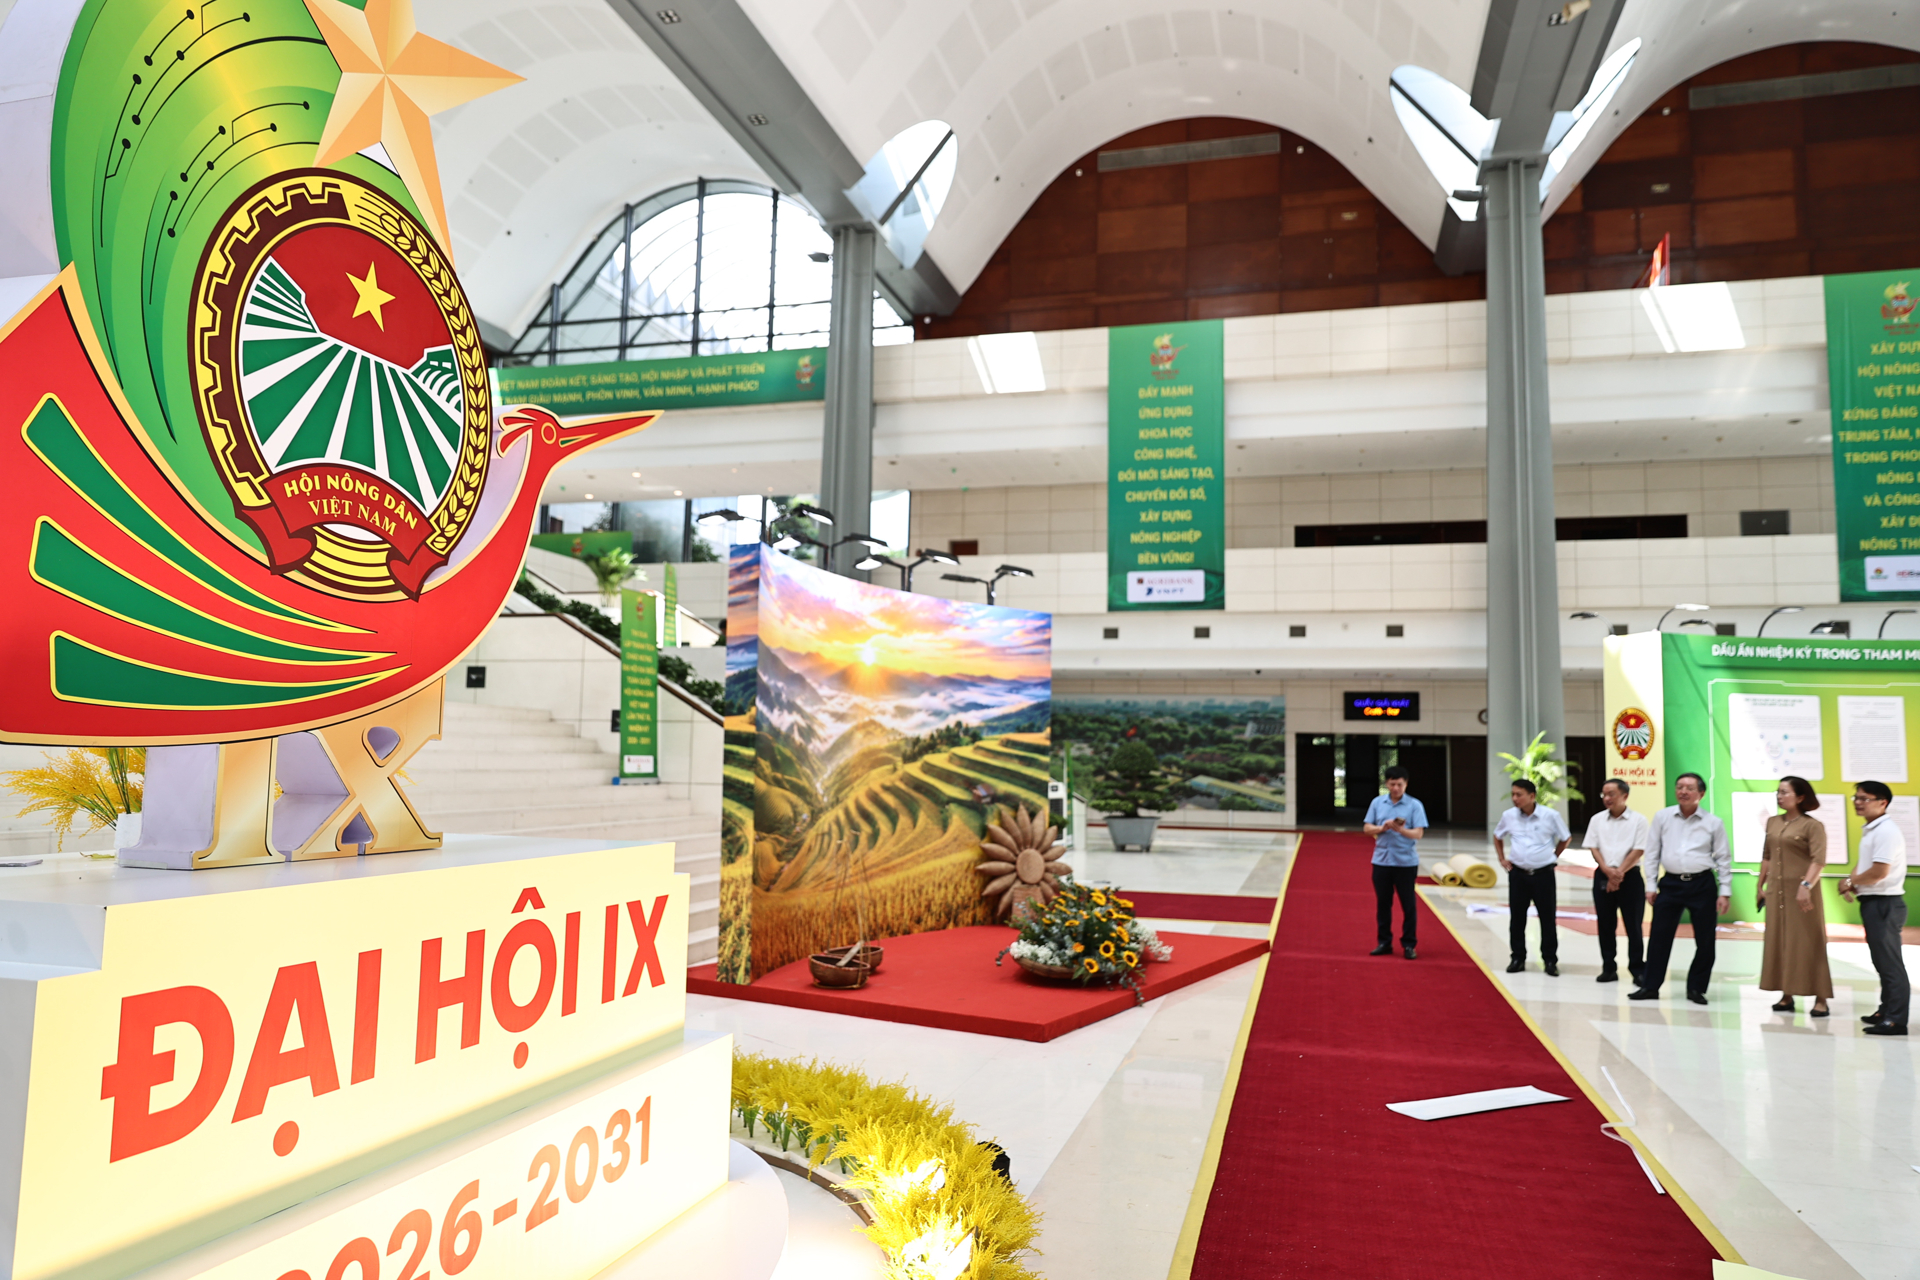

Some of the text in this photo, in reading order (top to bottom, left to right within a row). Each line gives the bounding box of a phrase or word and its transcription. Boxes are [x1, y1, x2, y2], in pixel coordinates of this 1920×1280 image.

[1871, 341, 1896, 355] XÂY
[516, 378, 540, 390] NAM
[590, 372, 616, 386] SÁNG
[641, 368, 659, 382] HỘI
[691, 364, 704, 378] VÀ
[706, 362, 732, 377] PHÁT
[1858, 363, 1880, 379] HỘI
[666, 384, 695, 398] MINH,
[696, 382, 726, 397] HẠNH
[1161, 385, 1193, 399] MẠNH
[1874, 383, 1903, 398] VIỆT
[1842, 404, 1918, 421] XỨNG ĐÁNG
[1139, 426, 1193, 440] KHOA HỌC
[1838, 430, 1880, 443] TRUNG
[1882, 426, 1914, 442] TÂM,
[1134, 446, 1164, 461] CÔNG
[1844, 451, 1889, 464] TRONG
[1160, 466, 1190, 480] SÁNG
[1191, 466, 1215, 481] TẠO,
[1877, 470, 1914, 484] NÔNG
[284, 473, 418, 530] HỘI NÔNG DÂN
[1863, 492, 1882, 506] VÀ
[308, 496, 397, 536] VIỆT NAM
[1140, 508, 1160, 522] XÂY
[1880, 514, 1906, 528] XÂY
[1130, 528, 1202, 544] NÔNG NGHIỆP
[1860, 536, 1898, 551] NÔNG
[1756, 644, 1794, 661] NHIỆM
[1815, 648, 1861, 660] TRONG
[1862, 648, 1902, 660] THAM
[100, 886, 670, 1164] ĐẠI HỘI IX
